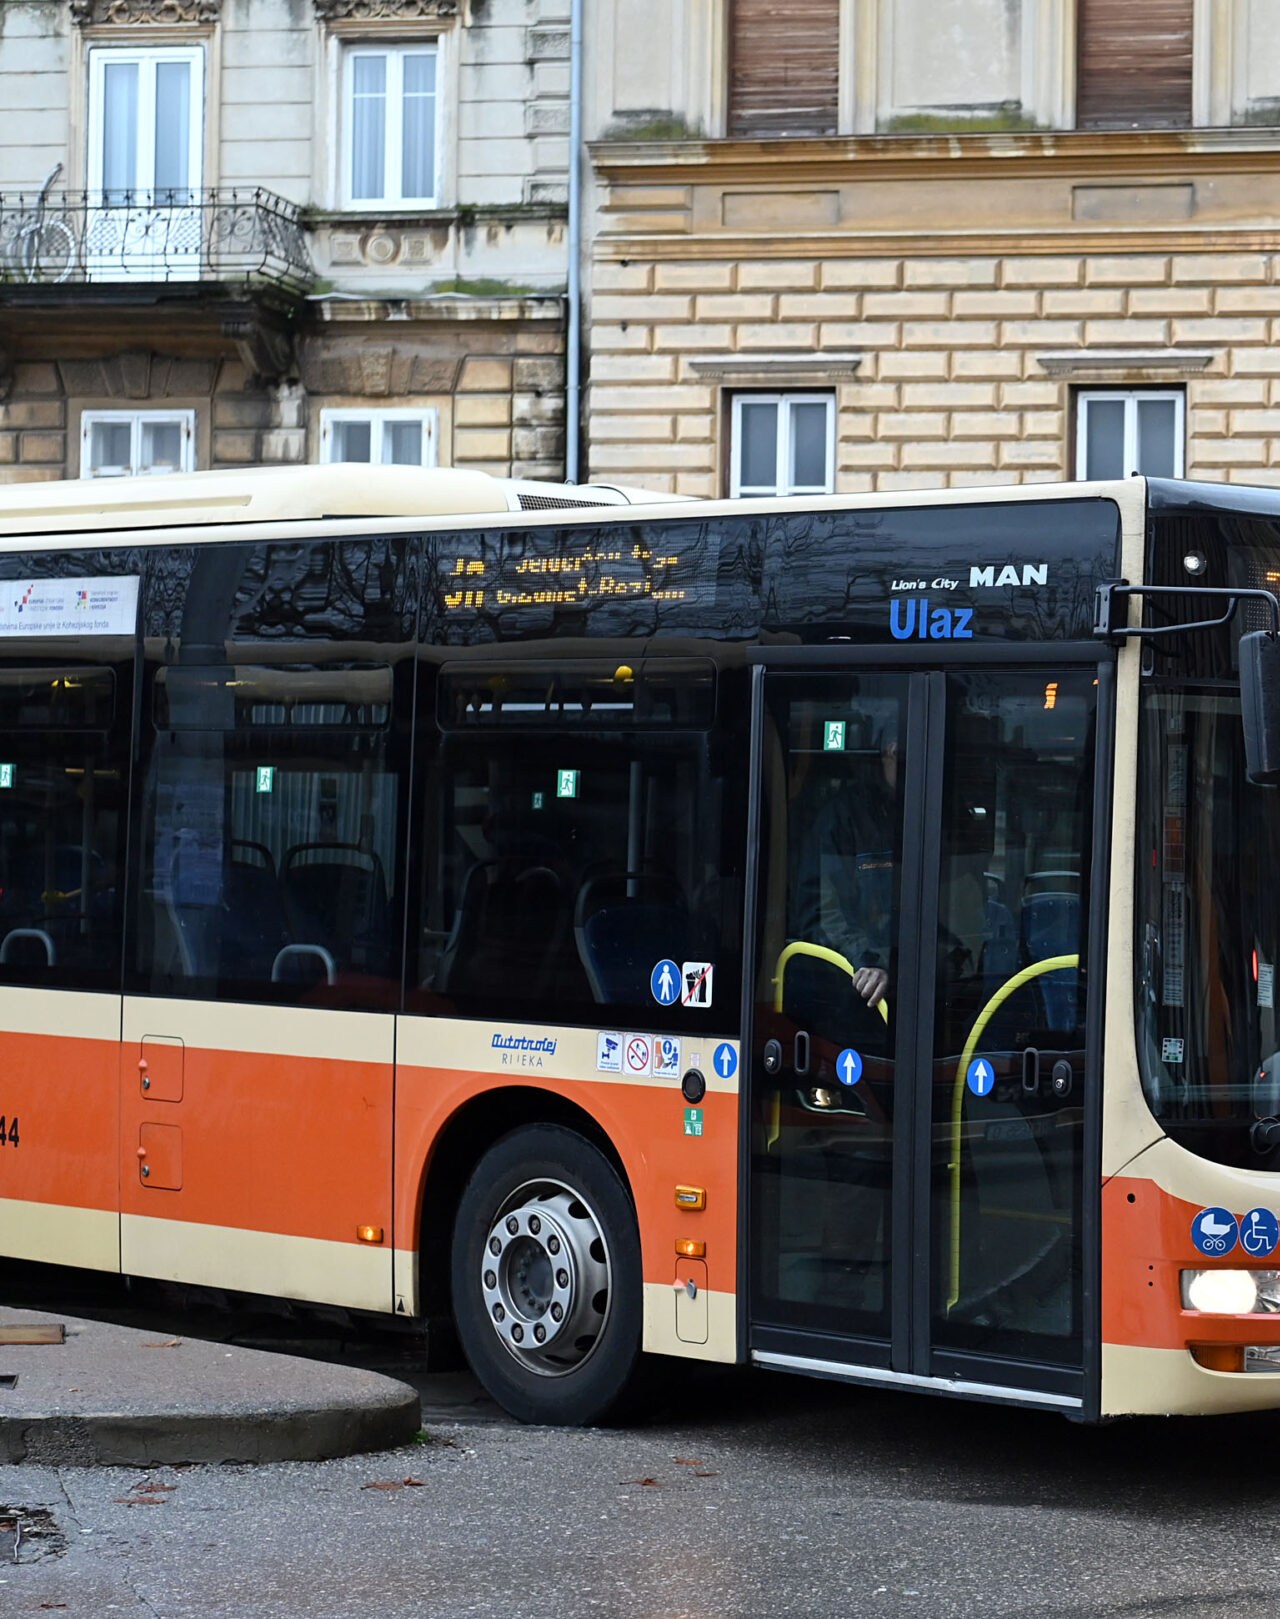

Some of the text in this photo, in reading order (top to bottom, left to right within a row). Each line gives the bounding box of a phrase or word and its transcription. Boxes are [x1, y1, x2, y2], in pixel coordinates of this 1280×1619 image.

[891, 577, 959, 591] Lion's City
[969, 563, 1048, 587] MAN
[889, 598, 973, 640] Ulaz
